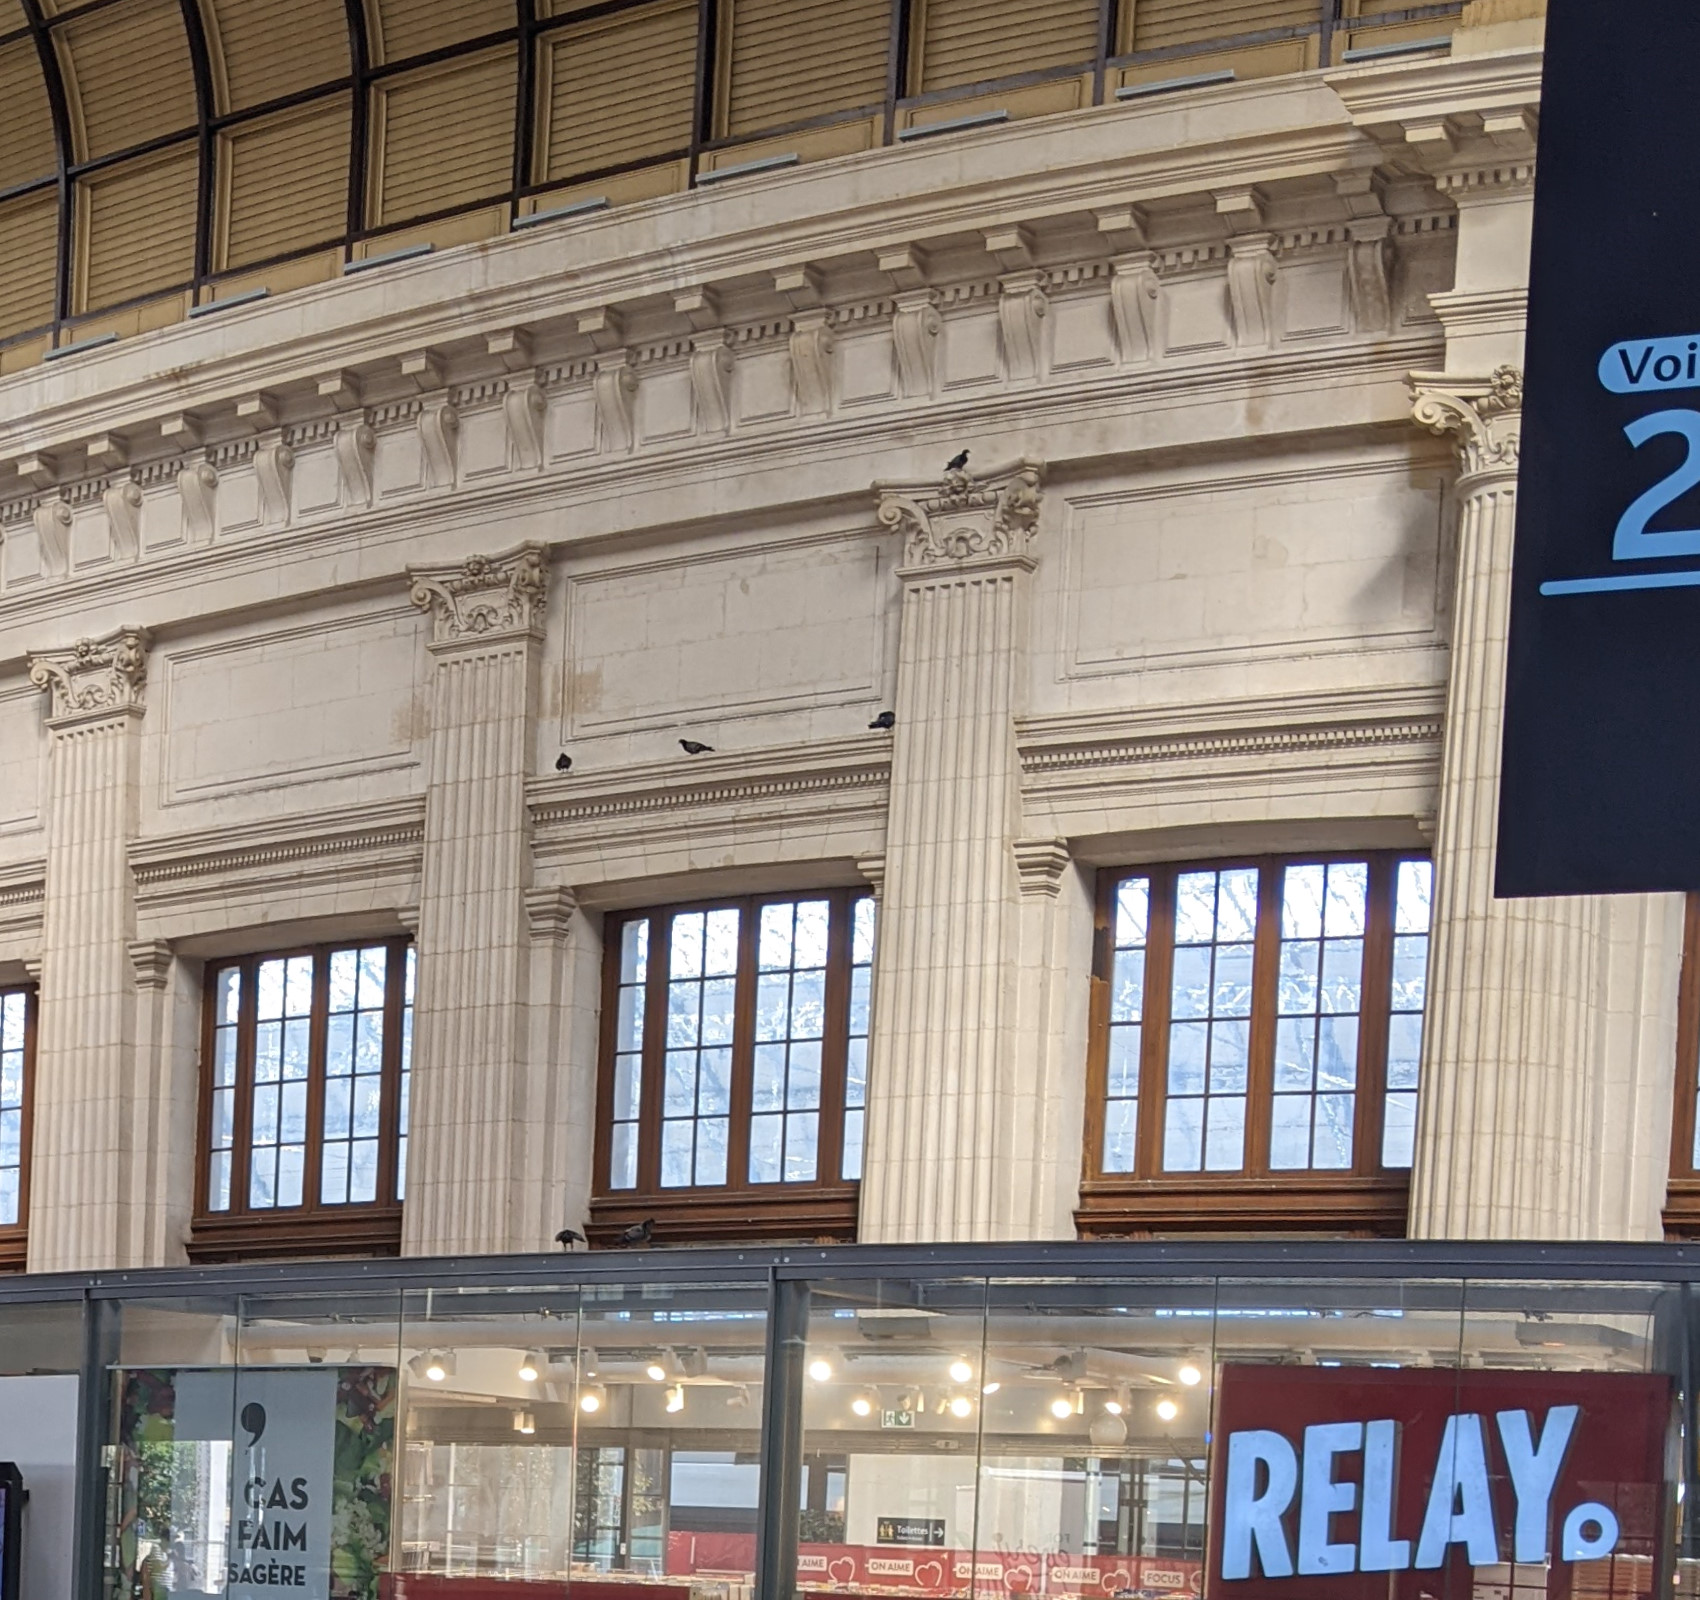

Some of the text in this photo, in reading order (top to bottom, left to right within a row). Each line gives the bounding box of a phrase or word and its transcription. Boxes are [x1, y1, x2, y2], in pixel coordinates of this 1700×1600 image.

[1612, 408, 1700, 561] 2
[237, 1520, 307, 1552] FAIM
[897, 1525, 929, 1535] Toilettes
[802, 1556, 826, 1569] AIME
[871, 1561, 912, 1573] ON AIME
[975, 1565, 1000, 1578] AIME
[1054, 1569, 1098, 1582] ON AIME
[1146, 1572, 1183, 1584] FOCUS
